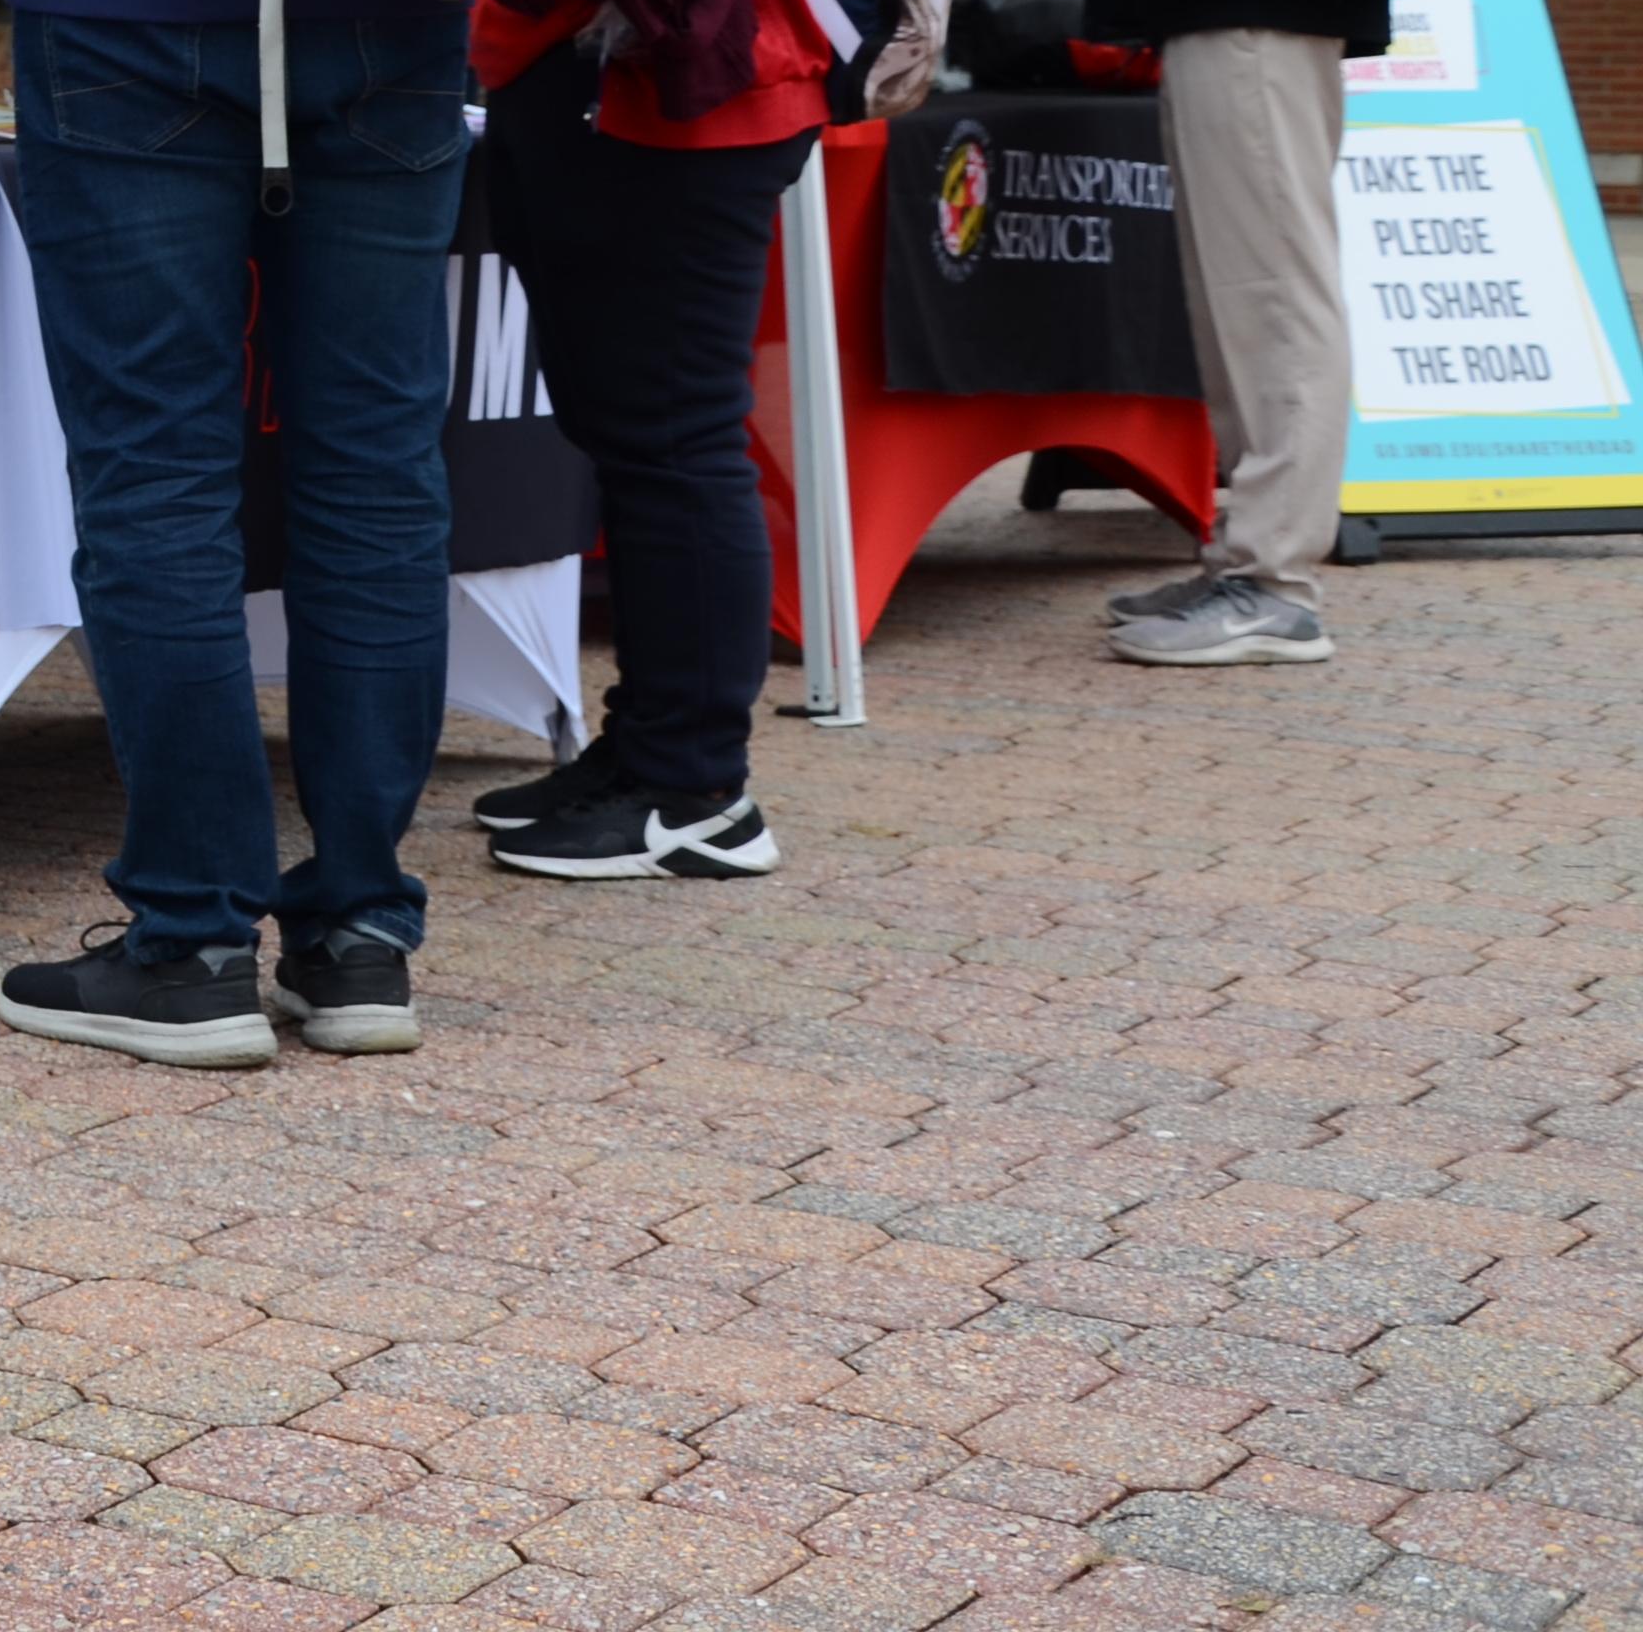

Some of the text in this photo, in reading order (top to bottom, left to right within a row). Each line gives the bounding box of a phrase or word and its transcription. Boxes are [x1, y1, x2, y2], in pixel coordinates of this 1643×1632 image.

[1340, 154, 1494, 194] TAKE THE
[991, 210, 1114, 263] SERVICES
[1372, 217, 1496, 257] PLEDGE
[1371, 280, 1530, 321] TO SHARE
[1391, 344, 1553, 385] THE ROAD
